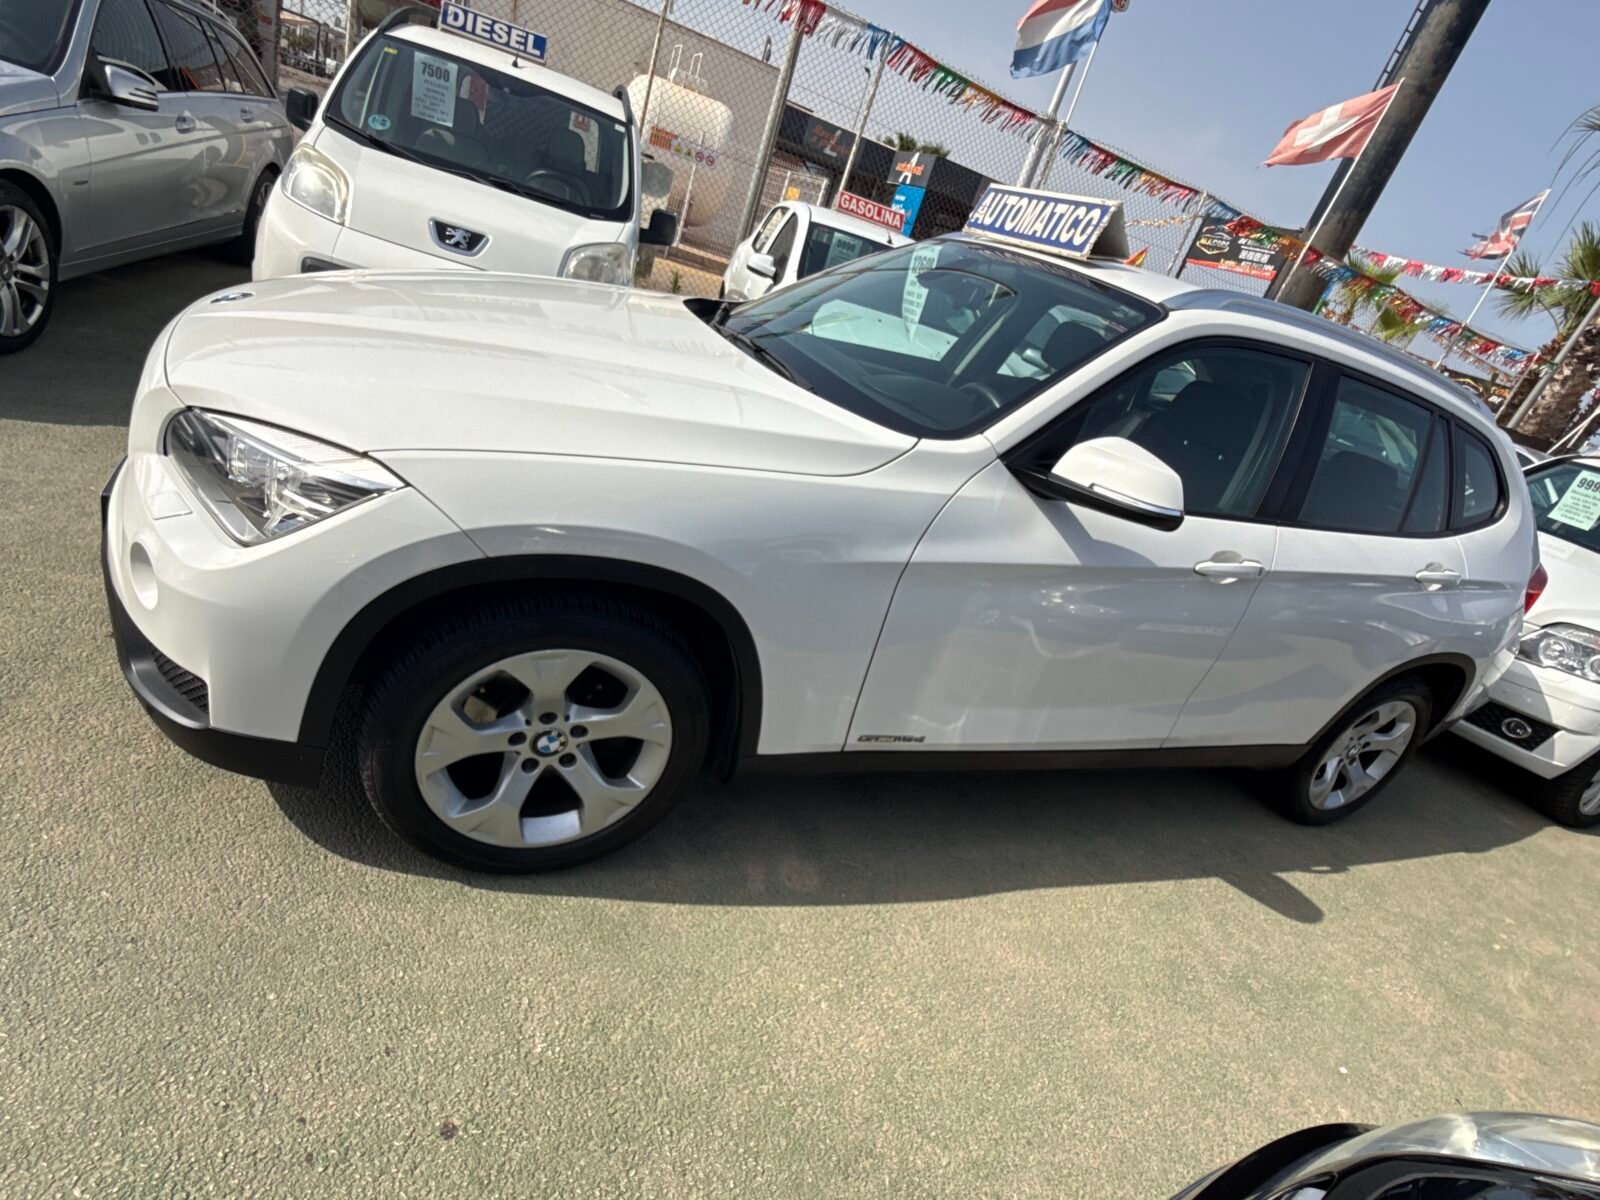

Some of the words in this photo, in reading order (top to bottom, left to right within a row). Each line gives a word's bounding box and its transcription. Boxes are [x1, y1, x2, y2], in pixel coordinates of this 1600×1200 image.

[447, 7, 540, 56] DIESEL
[421, 62, 450, 82] 7500
[840, 195, 901, 228] GASOLINA
[971, 192, 1101, 246] AUTOMATICO
[1577, 477, 1600, 493] 999
